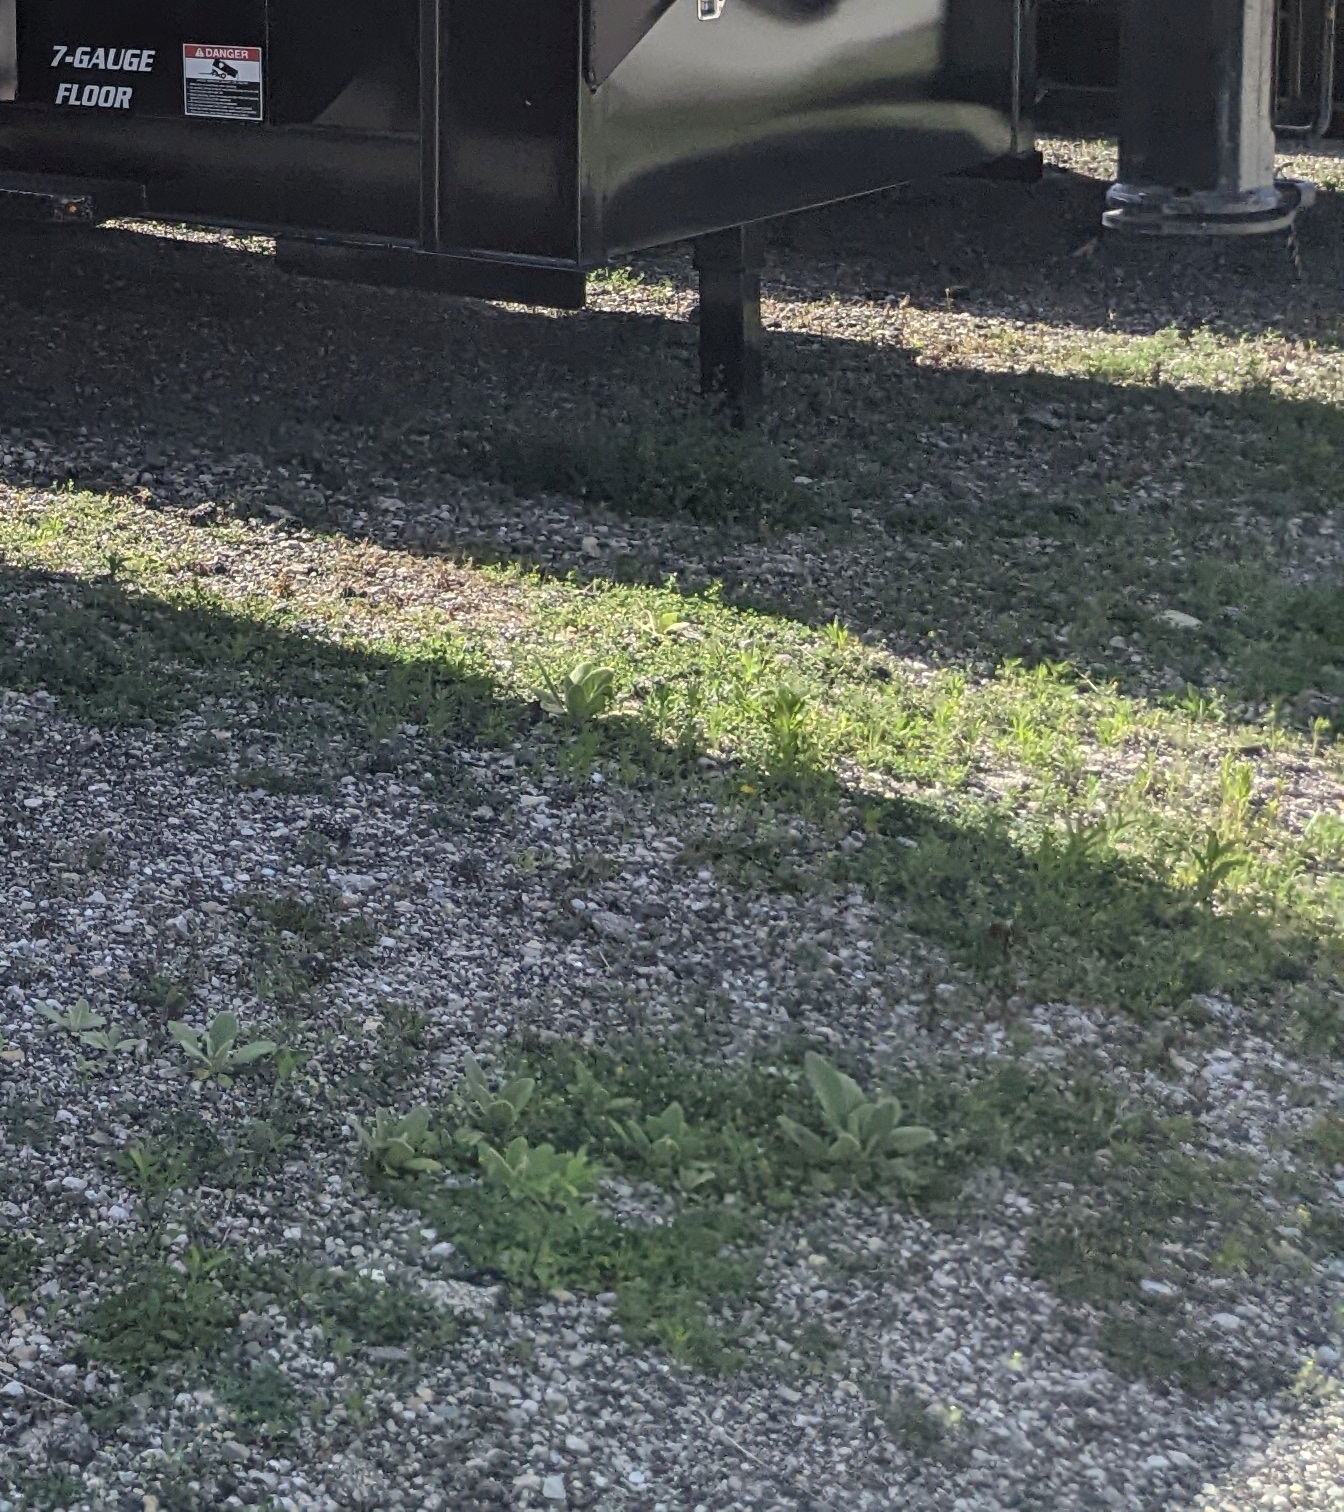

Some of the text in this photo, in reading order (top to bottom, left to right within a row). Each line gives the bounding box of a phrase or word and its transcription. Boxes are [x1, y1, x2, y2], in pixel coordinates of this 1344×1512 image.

[50, 45, 156, 72] 7-GAUGE
[205, 48, 249, 59] DANGER
[55, 83, 133, 109] FLOOR
